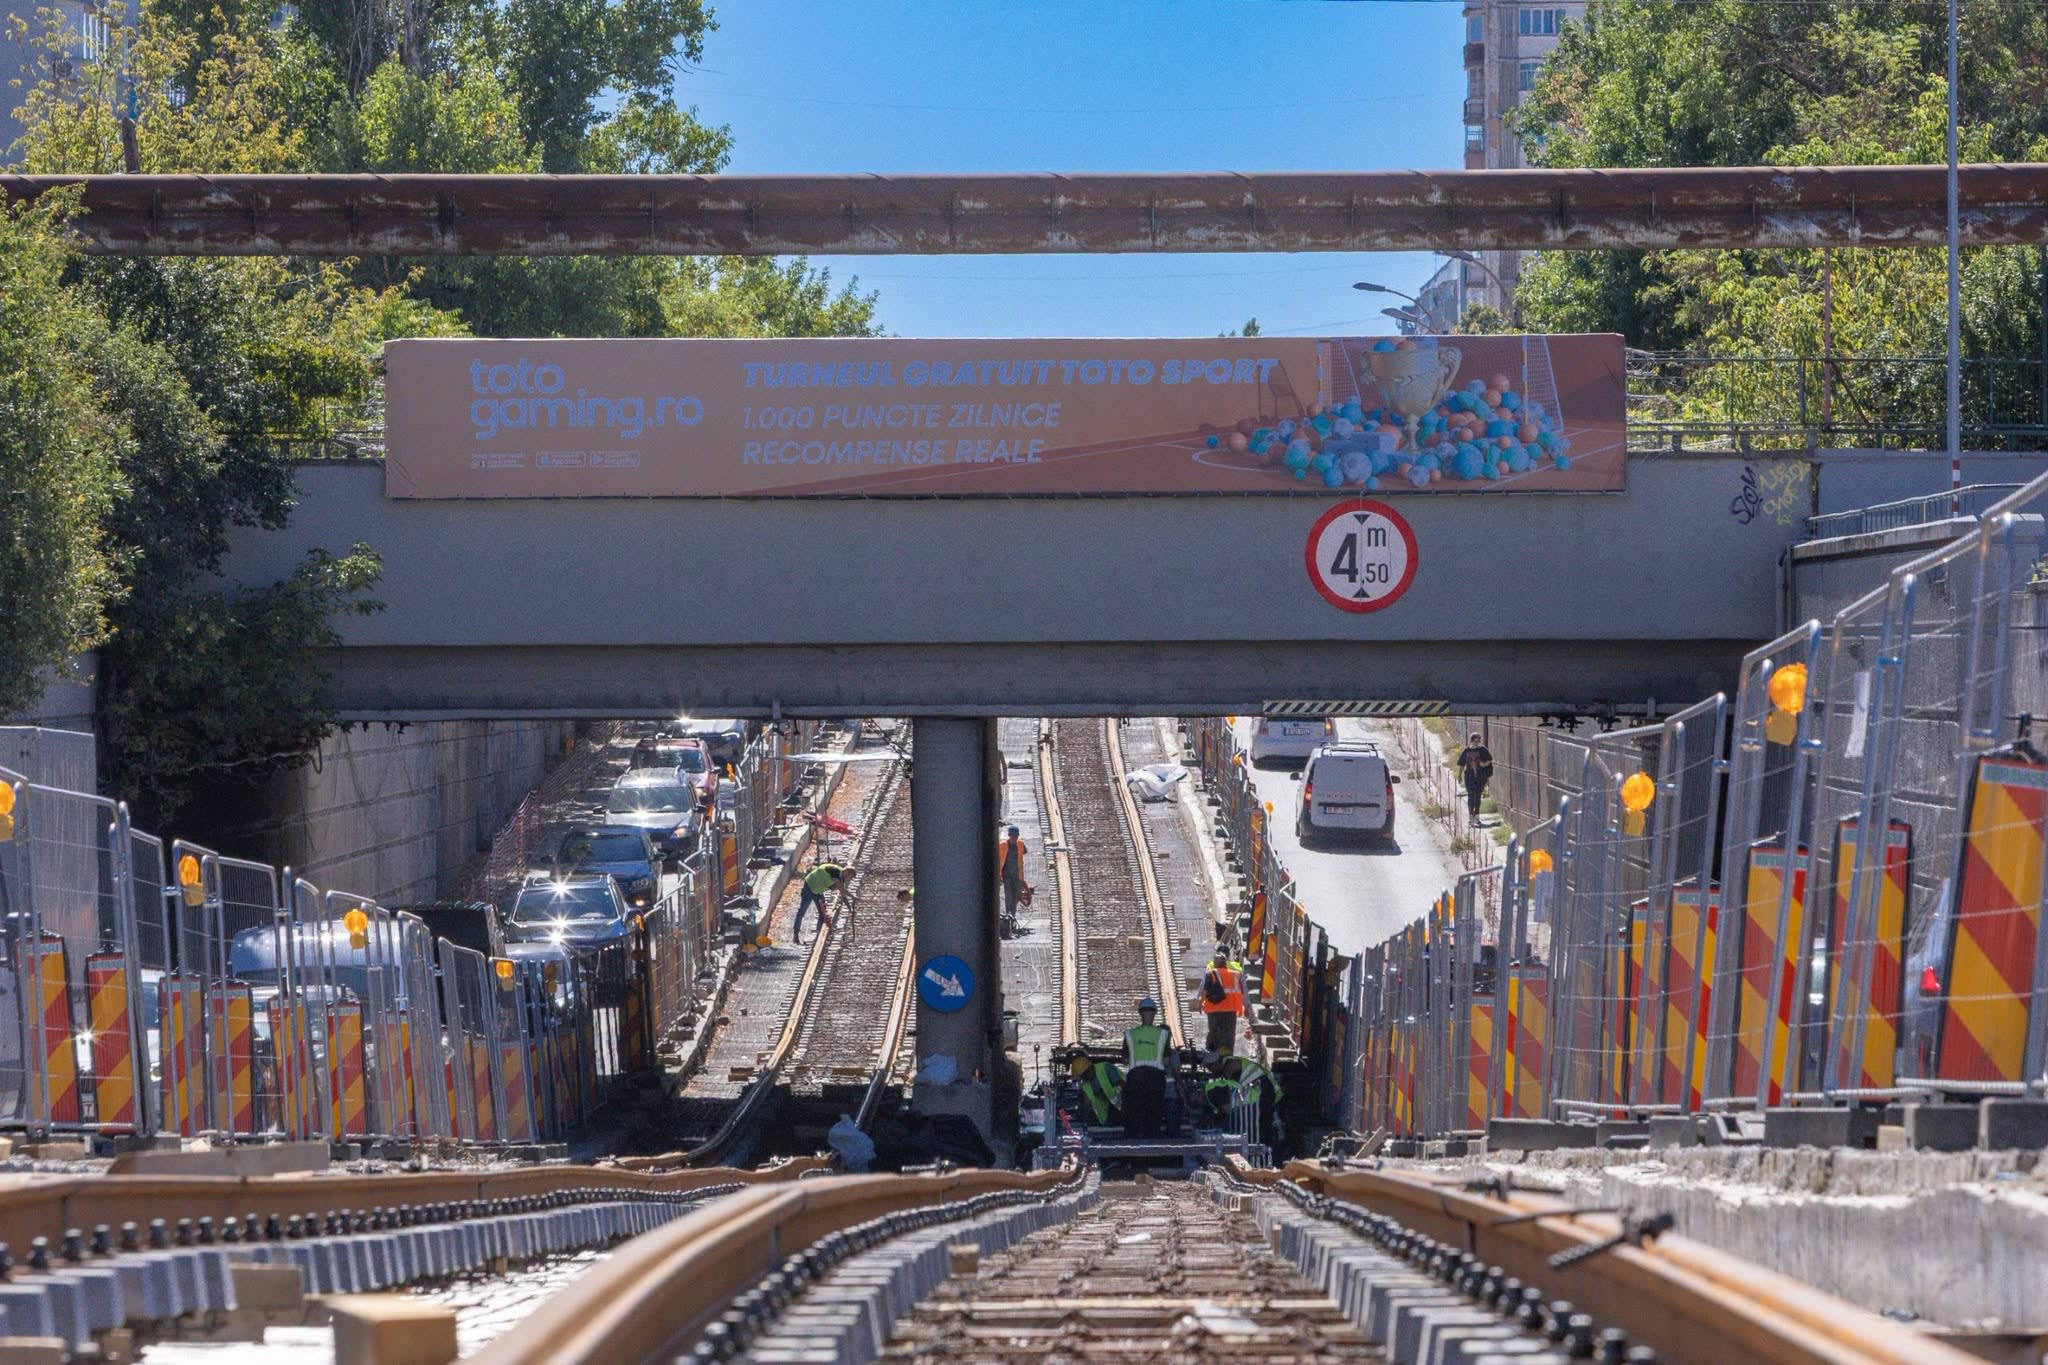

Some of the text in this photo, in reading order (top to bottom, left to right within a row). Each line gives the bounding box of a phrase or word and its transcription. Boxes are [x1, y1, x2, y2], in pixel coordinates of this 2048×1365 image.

[470, 358, 566, 394] toto
[743, 358, 1279, 388] TURNEUL GRATUIT TOTO SPORT
[470, 387, 704, 440] gaming.ro
[743, 402, 1062, 430] 1.000 PUNCTE ZILNICE
[743, 439, 1045, 466] RECOMPENSE REALE
